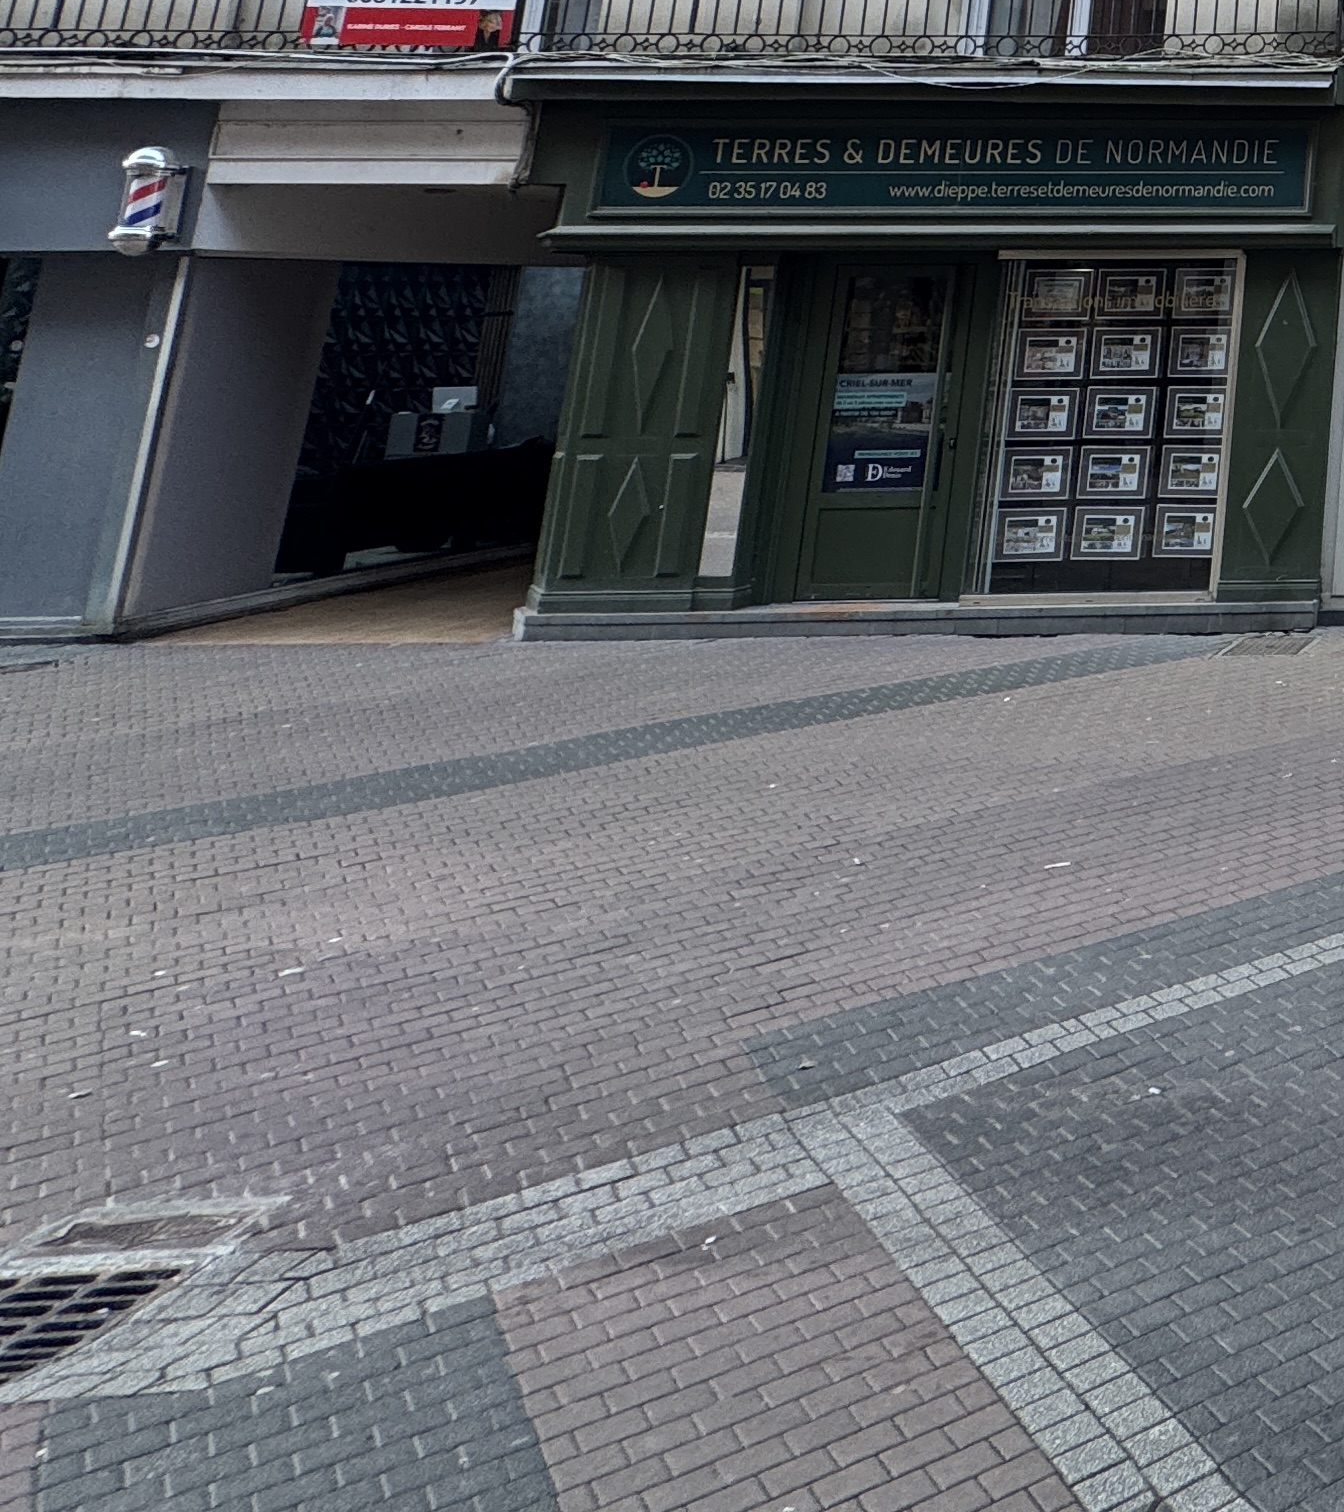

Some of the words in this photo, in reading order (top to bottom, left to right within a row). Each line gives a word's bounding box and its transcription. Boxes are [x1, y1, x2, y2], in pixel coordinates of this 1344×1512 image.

[711, 139, 831, 164] TERRES
[843, 139, 864, 164] &
[877, 139, 1043, 164] DEMEURES
[1055, 139, 1094, 165] DE
[1105, 139, 1280, 165] NORMANDIE
[708, 181, 728, 199] 02
[733, 181, 756, 199] 35
[759, 181, 777, 199] 17
[779, 181, 801, 199] 04
[804, 181, 828, 199] 83
[888, 180, 1275, 202] www.dieppe.terresetdemeuresdenormandie.com
